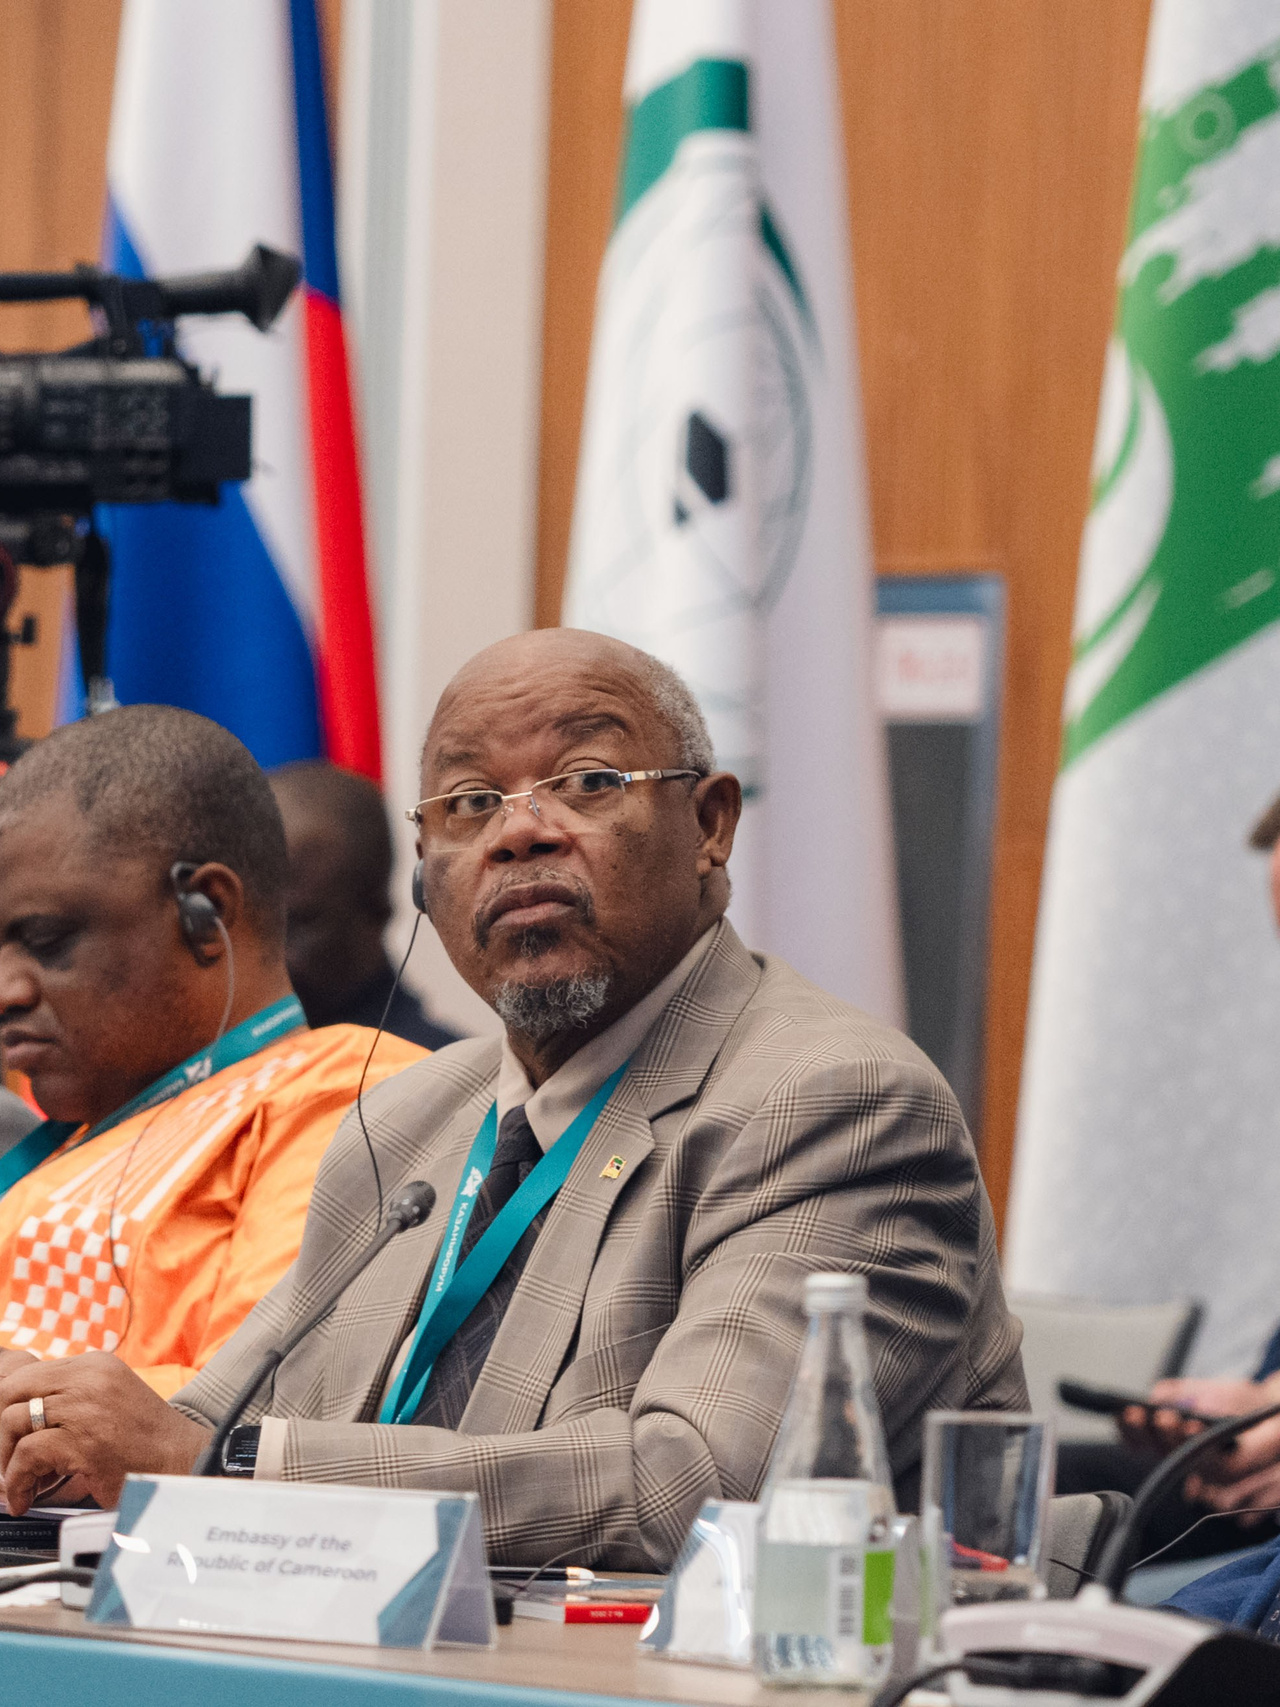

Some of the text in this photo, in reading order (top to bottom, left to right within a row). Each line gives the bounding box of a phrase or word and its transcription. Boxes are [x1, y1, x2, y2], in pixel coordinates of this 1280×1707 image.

[435, 1202, 469, 1292] КАЗАНЬФОРУМ
[206, 1526, 352, 1551] Embassy of the
[254, 1557, 276, 1573] of
[278, 1559, 378, 1582] Cameroon
